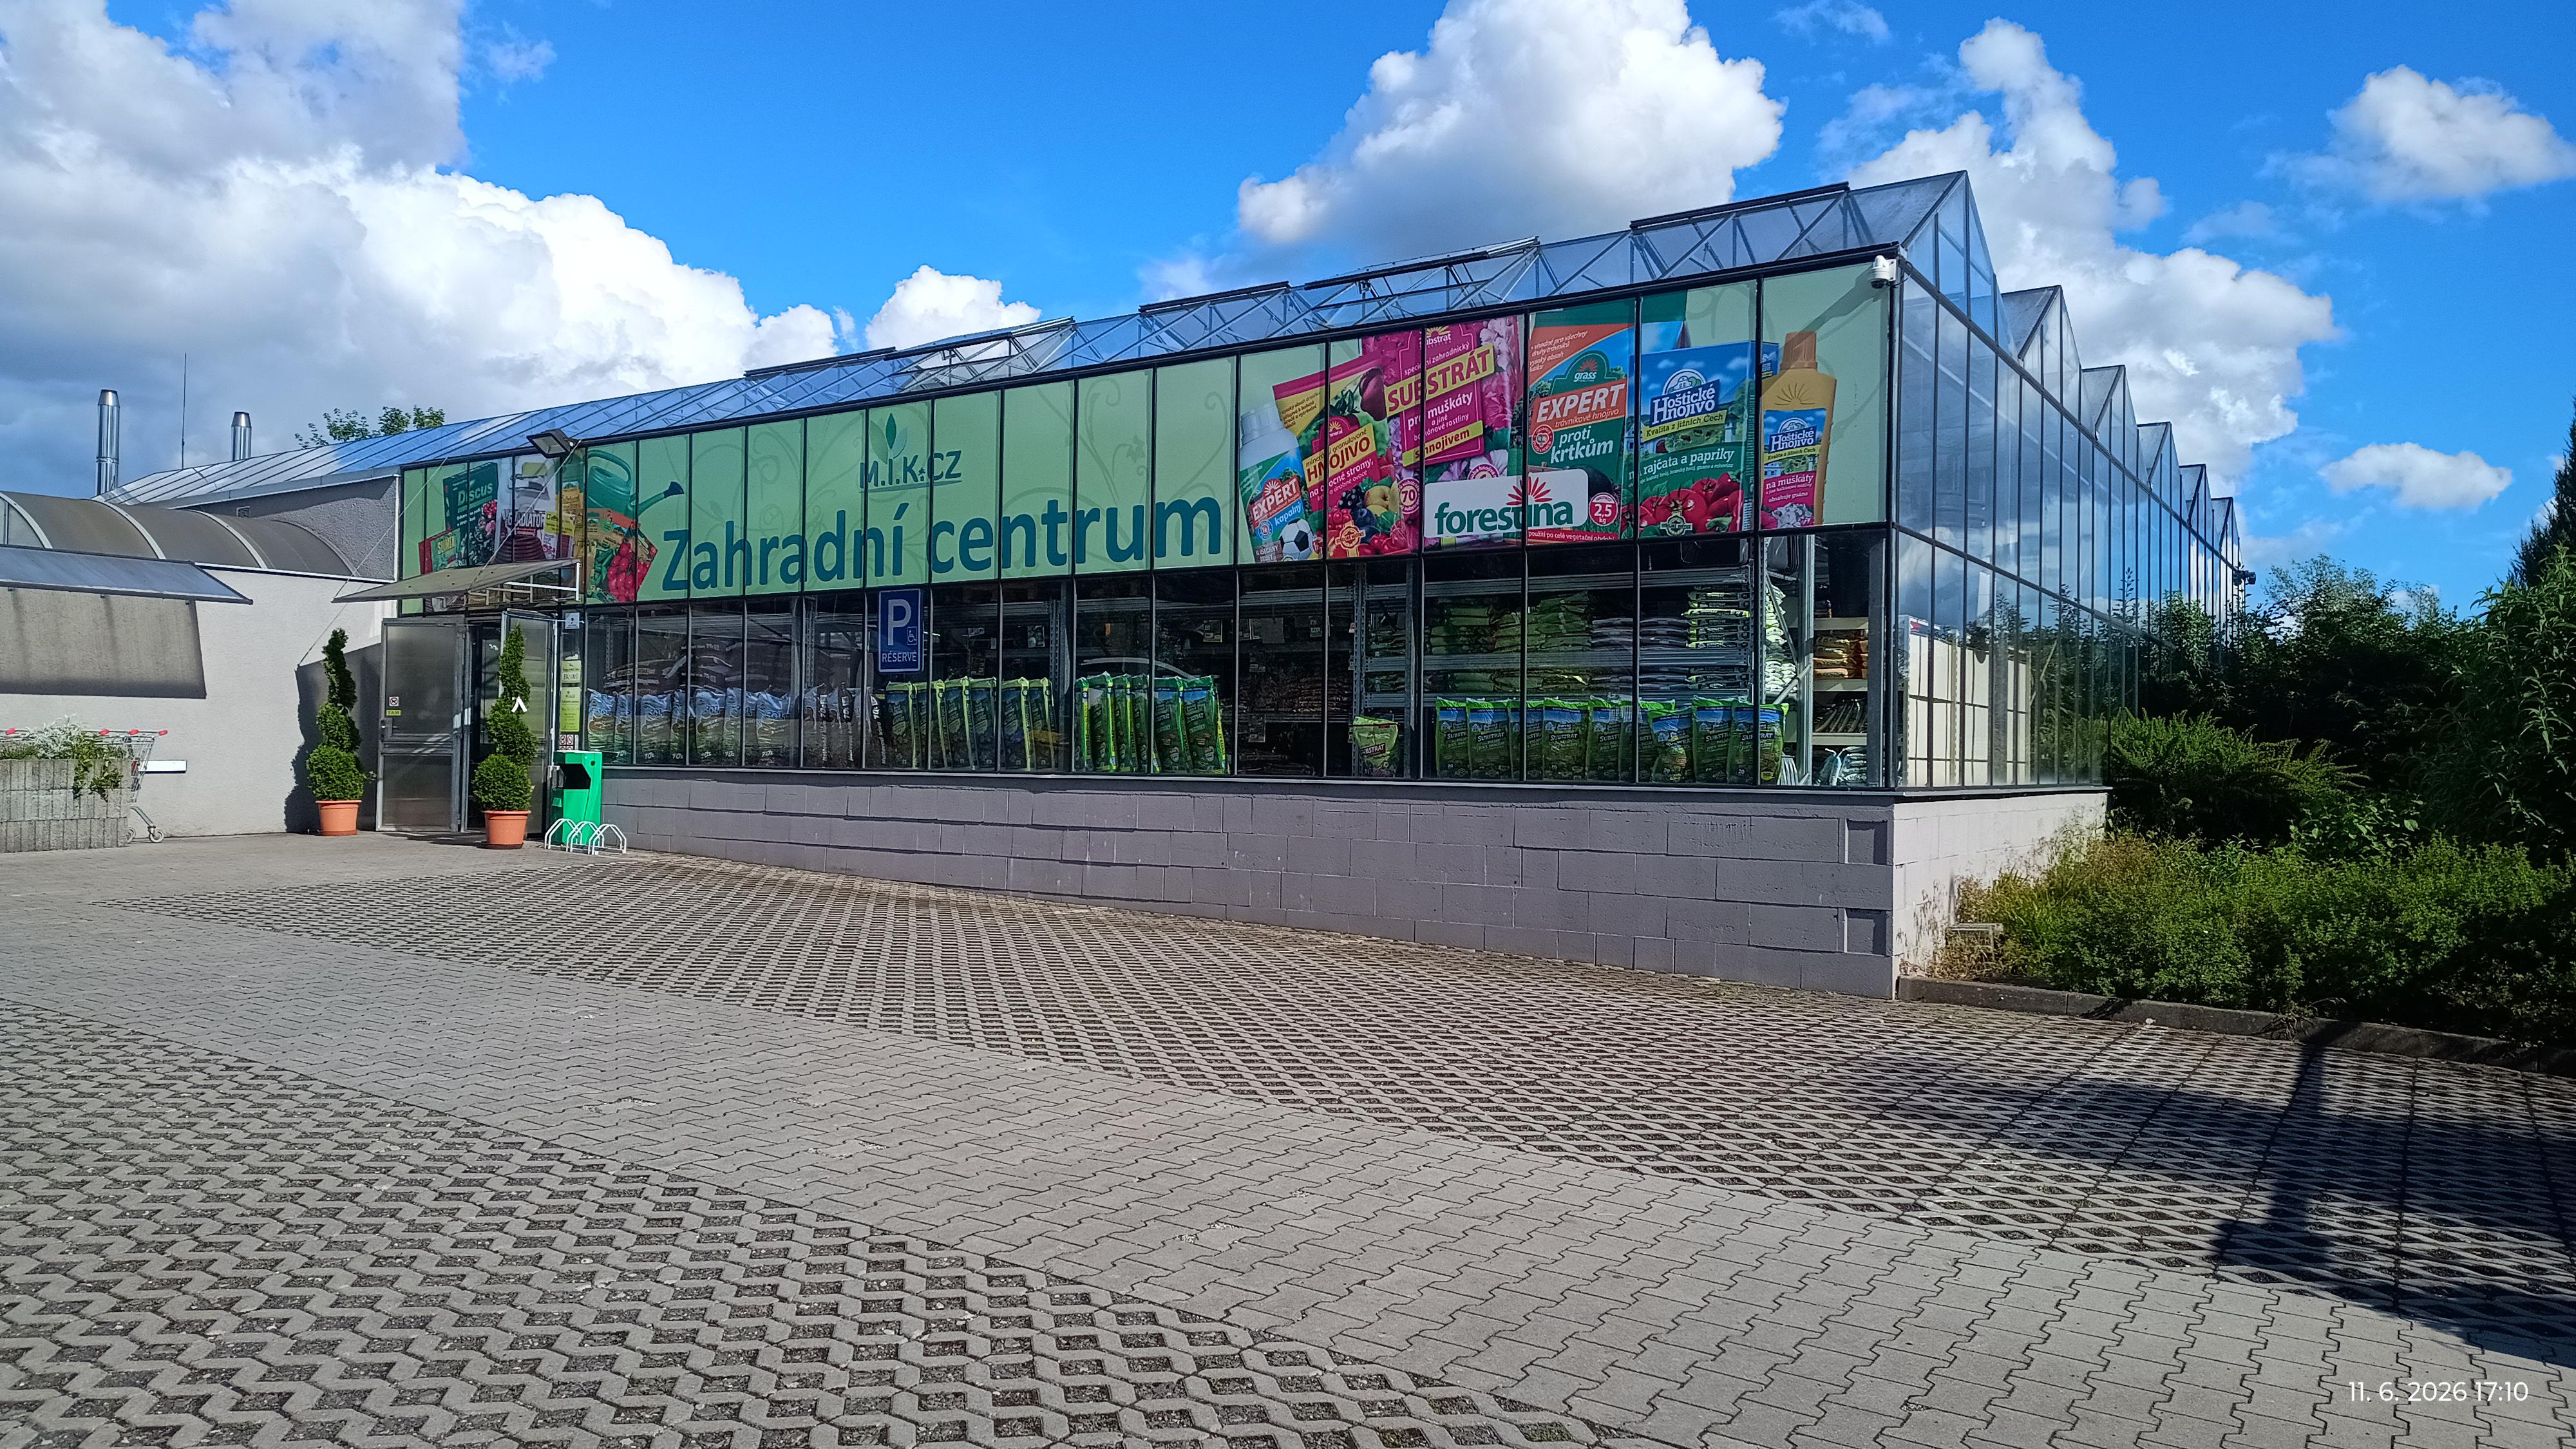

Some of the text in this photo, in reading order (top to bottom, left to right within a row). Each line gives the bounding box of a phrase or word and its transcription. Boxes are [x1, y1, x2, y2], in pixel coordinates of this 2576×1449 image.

[1432, 341, 1470, 363] zahradnický
[1553, 337, 1564, 346] pro
[1388, 348, 1490, 412] SUBSTRÁT
[1573, 372, 1597, 383] grass
[1428, 392, 1473, 419] muškáty
[1537, 384, 1625, 423] EXPERT
[1652, 383, 1716, 425] Hoštické
[1436, 414, 1448, 426] jiné
[1446, 413, 1469, 428] rostliny
[1555, 408, 1620, 428] trávníkové hnojivo
[1646, 425, 1670, 437] Kvalita
[1677, 417, 1701, 430] jižních
[1703, 413, 1723, 422] Čech
[1332, 428, 1367, 453] granulované
[1559, 426, 1591, 448] proti
[1770, 428, 1814, 452] Hoštické
[1550, 438, 1614, 464] krtkům
[1643, 457, 1678, 475] rajčata
[1681, 455, 1687, 464] a
[1689, 448, 1734, 466] papriky
[1309, 489, 1319, 498] na
[1347, 458, 1374, 477] stromy,
[1777, 475, 1814, 486] muškáty
[1253, 478, 1297, 520] EXPERT
[1402, 489, 1416, 503] 70
[1274, 502, 1302, 526] kapalný
[1435, 501, 1573, 535] forestina
[1595, 503, 1612, 518] 2,5
[662, 497, 1221, 591] Zahradní centrum
[1555, 531, 1566, 540] celé
[1566, 533, 1593, 542] vegetační
[887, 599, 911, 646] P
[882, 650, 917, 663] RÉSERVÉ
[1477, 732, 1505, 743] SUBSTRAT
